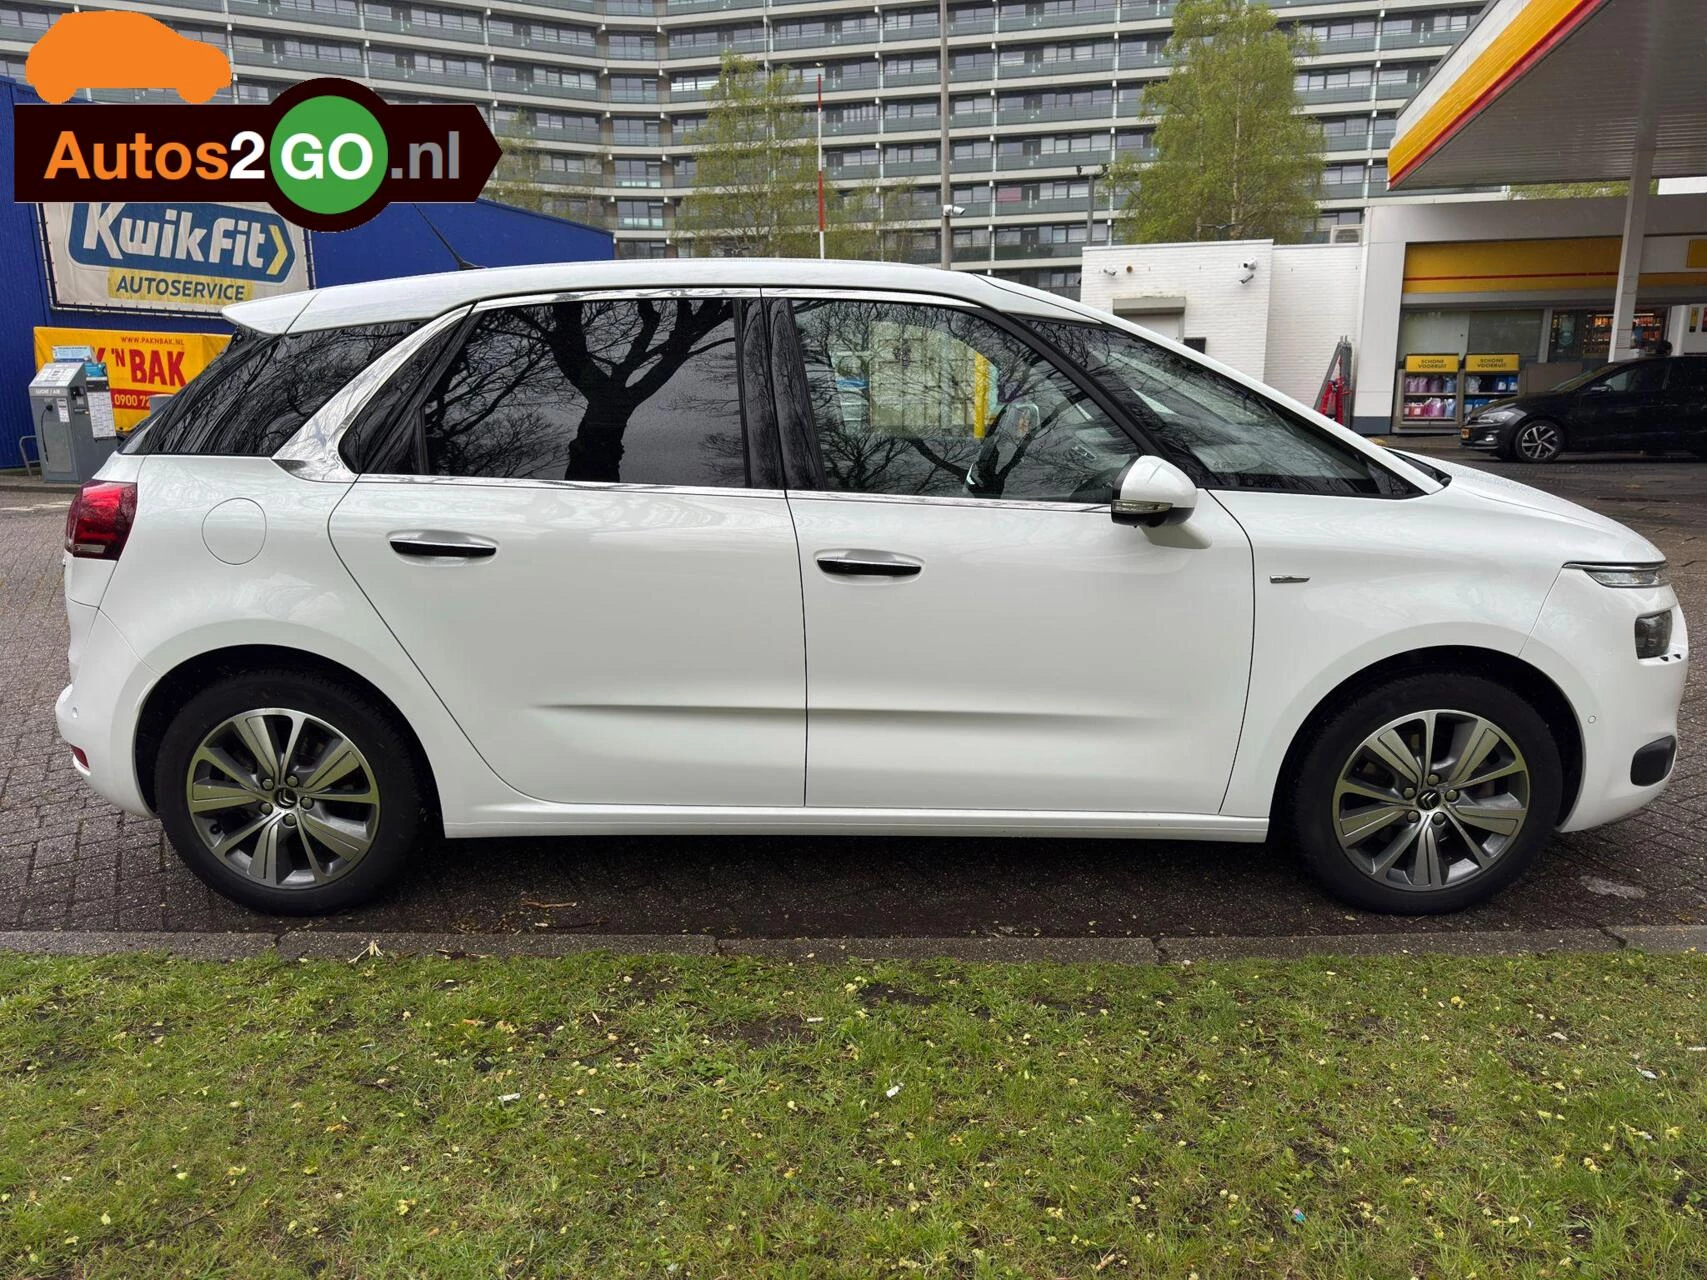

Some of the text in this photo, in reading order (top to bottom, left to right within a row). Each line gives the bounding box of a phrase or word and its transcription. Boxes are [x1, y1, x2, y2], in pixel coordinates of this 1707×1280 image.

[116, 275, 245, 301] AUTOSERVICE
[120, 336, 185, 346] WWW.PAKNBAK.NL
[129, 349, 187, 387] BAK
[114, 394, 138, 406] 0900
